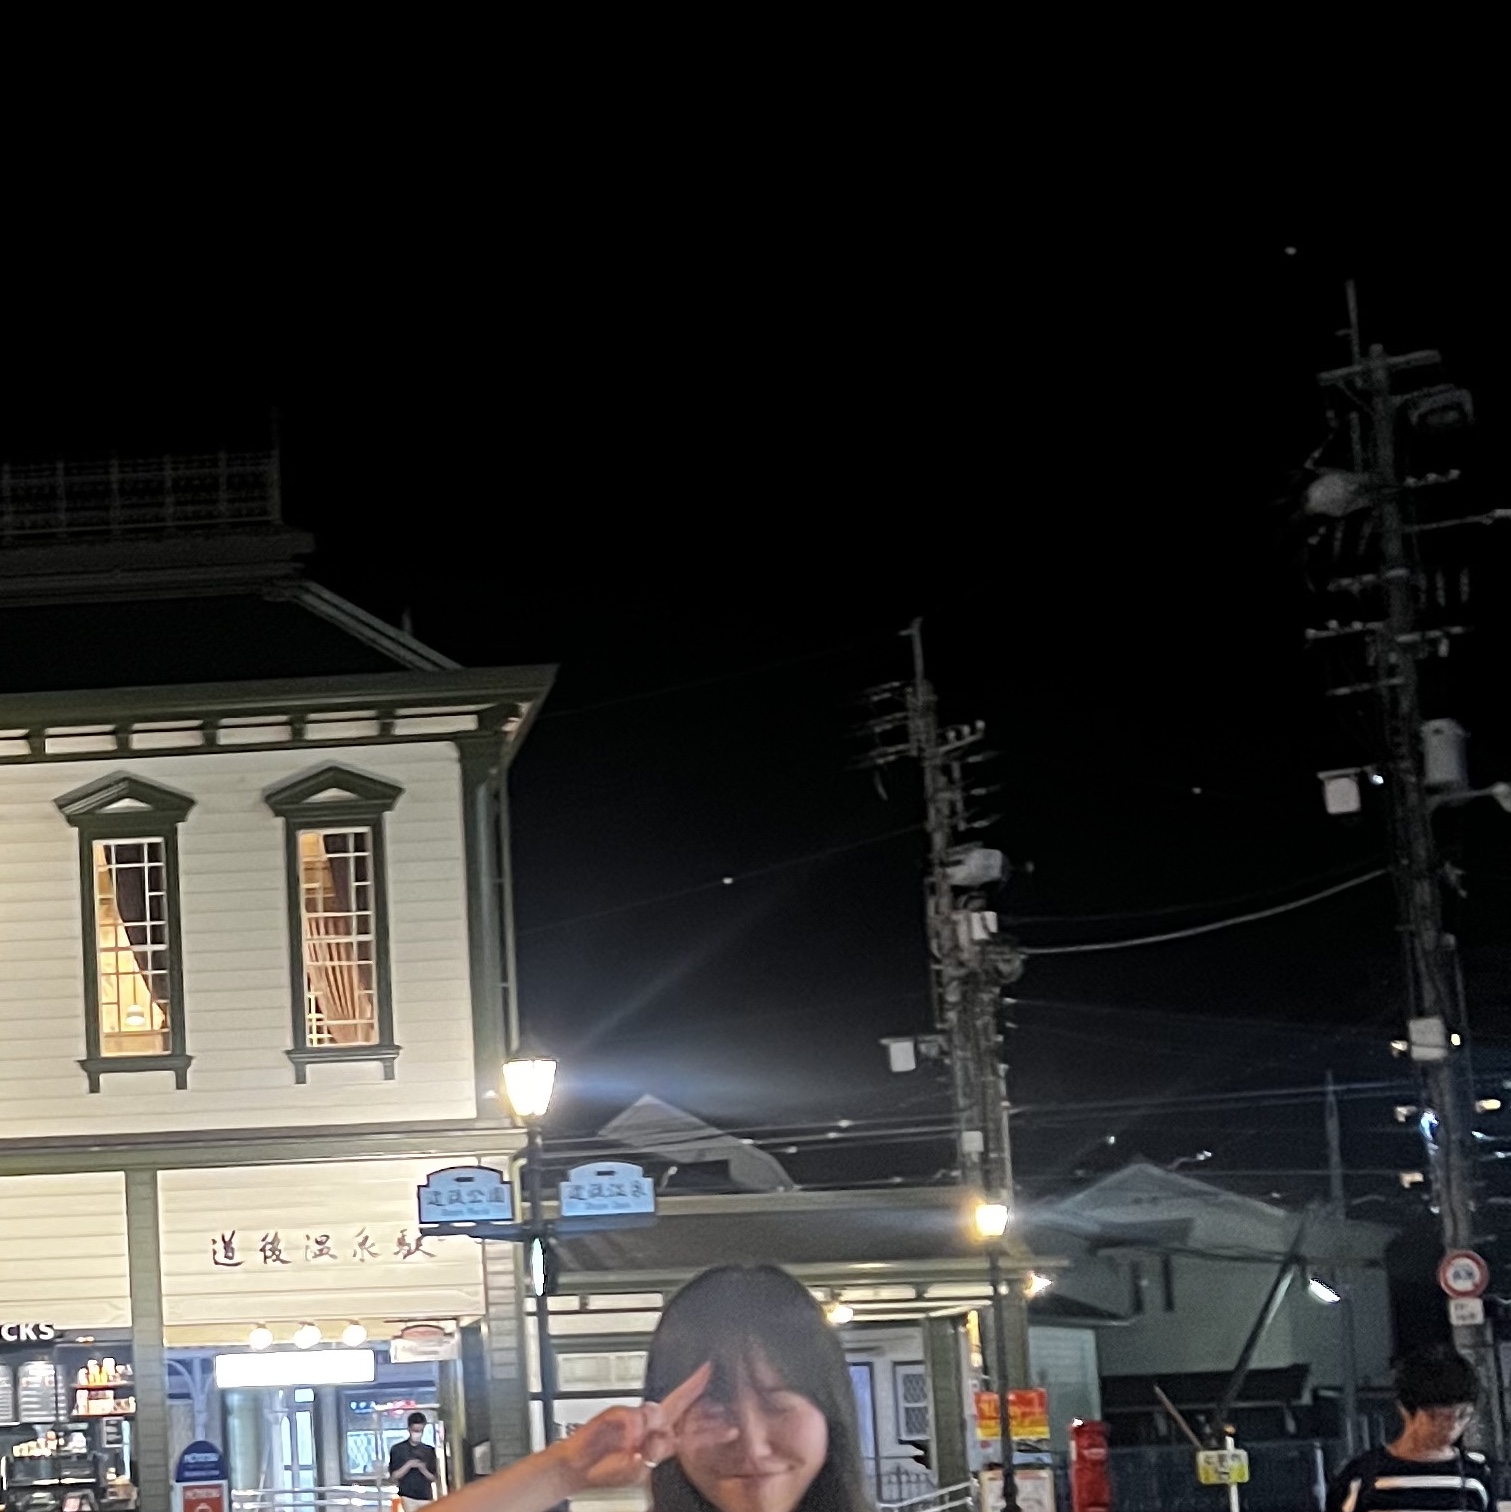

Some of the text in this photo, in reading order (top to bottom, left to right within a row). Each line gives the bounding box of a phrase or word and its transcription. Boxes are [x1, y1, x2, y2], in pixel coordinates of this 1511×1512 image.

[211, 1227, 437, 1267] 道後温泉駅
